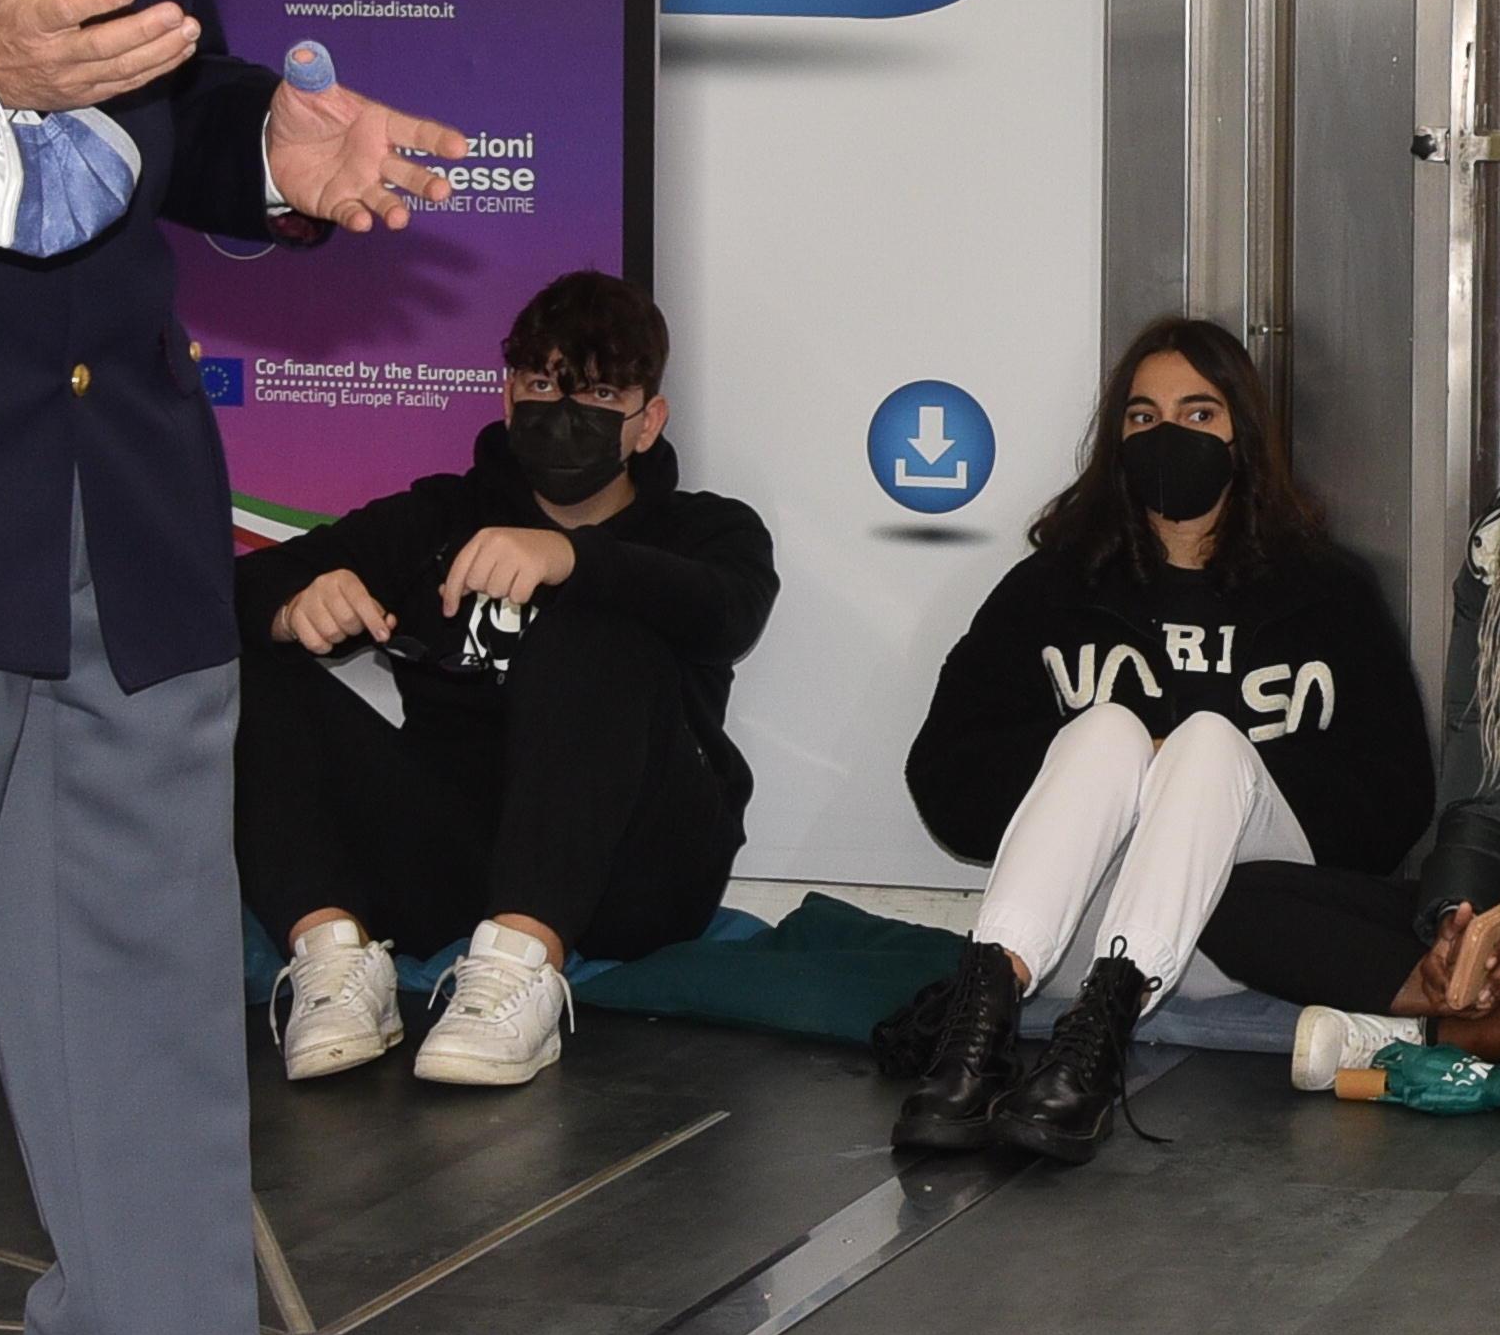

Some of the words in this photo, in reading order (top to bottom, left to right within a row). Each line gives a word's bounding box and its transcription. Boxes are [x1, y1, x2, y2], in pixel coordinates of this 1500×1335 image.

[285, 0, 456, 20] www.poliziadistato.it
[476, 196, 535, 214] CENTRE
[256, 358, 354, 379] Co-financed
[359, 361, 380, 382] by
[385, 362, 412, 380] the
[418, 363, 497, 384] European
[255, 385, 337, 407] Connecting
[341, 389, 393, 409] Europe
[397, 391, 450, 412] Facility
